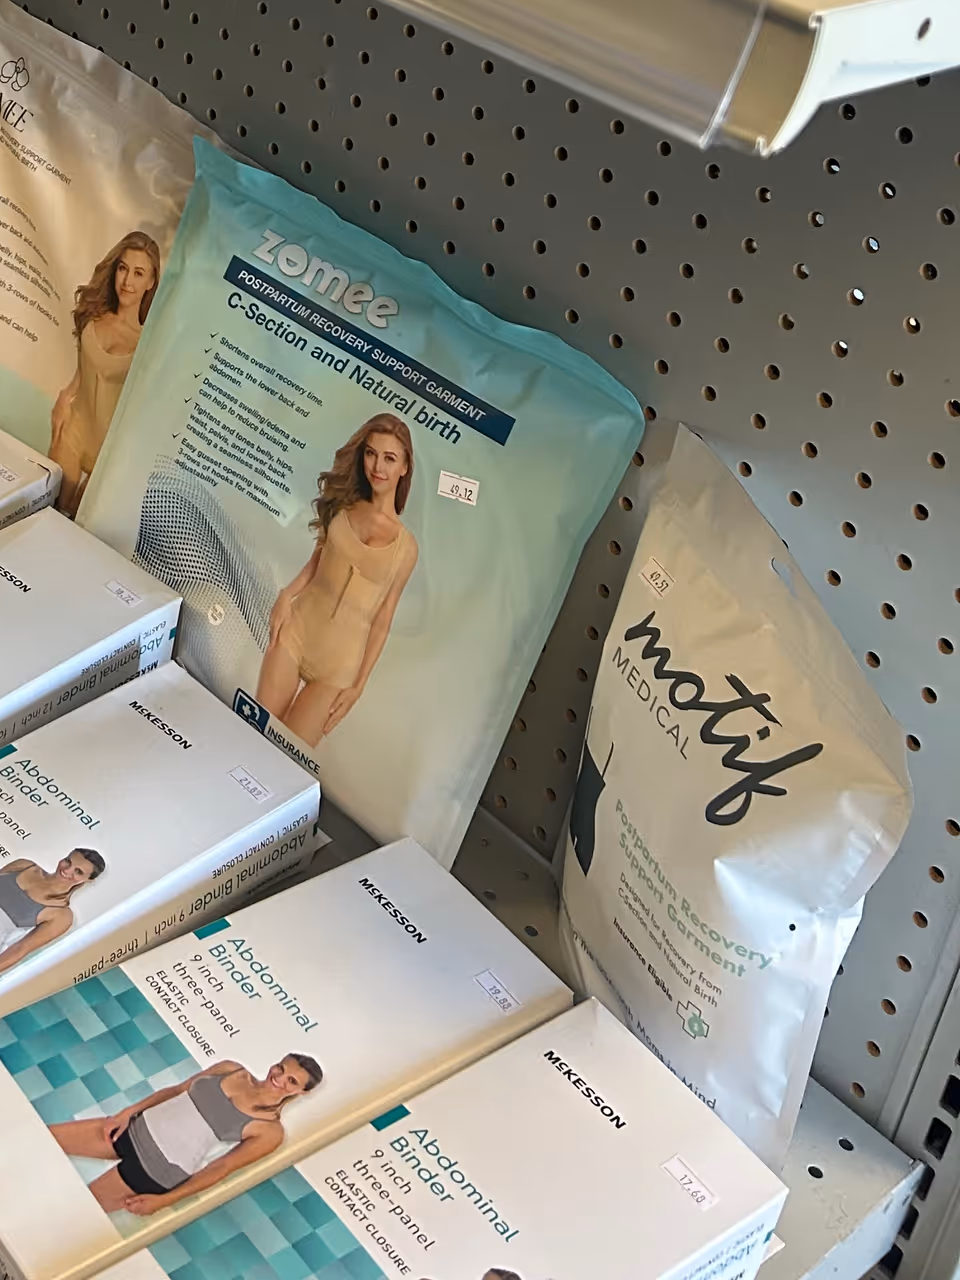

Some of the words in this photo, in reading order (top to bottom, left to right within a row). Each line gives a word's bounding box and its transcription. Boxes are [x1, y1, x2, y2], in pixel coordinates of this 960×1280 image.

[15, 144, 47, 166] SUPPORT
[45, 163, 71, 186] GARMENT
[251, 228, 400, 329] zomee
[208, 363, 241, 387] abdomen.
[219, 336, 249, 360] Shortens
[250, 357, 276, 375] overall
[275, 372, 307, 395] recovery
[306, 391, 322, 406] time.
[227, 292, 307, 350] C-Section
[310, 346, 350, 373] and
[348, 365, 416, 414] Natural
[413, 405, 460, 444] birth
[238, 270, 310, 317] POSTPARTUM
[309, 313, 371, 352] RECOVERY
[371, 348, 427, 385] SUPPORT
[425, 381, 485, 420] GARMENT
[202, 377, 238, 404] Decreases
[238, 402, 290, 439] swelling/edema
[290, 436, 306, 449] and
[213, 352, 244, 376] Supports
[244, 372, 257, 384] the
[257, 380, 278, 396] lower
[277, 392, 295, 408] back
[294, 405, 310, 417] and
[198, 388, 212, 400] can
[211, 396, 227, 410] help
[227, 406, 235, 415] to
[234, 412, 259, 432] reduce
[258, 427, 288, 452] bruising.
[180, 437, 197, 453] Easy
[196, 450, 222, 468] gusset
[222, 465, 252, 487] opening
[253, 483, 268, 497] with
[450, 484, 473, 501] 49.12
[612, 646, 690, 760] MEDICAL
[624, 610, 824, 827] motif
[266, 722, 322, 777] INSURANCE
[14, 759, 99, 829] Abdominal
[236, 830, 307, 888] Abdominal
[615, 799, 676, 900] Postpartum
[679, 891, 773, 969] Recovery
[188, 878, 233, 915] Binder
[618, 832, 663, 904] Support
[667, 897, 746, 979] Garment
[155, 969, 189, 1005] ELASTIC
[189, 954, 202, 962] 9
[197, 964, 223, 992] inch
[208, 944, 261, 998] Binder
[227, 939, 317, 1032] Abdominal
[613, 917, 646, 965] Insurance
[647, 963, 672, 1001] Eligible
[145, 975, 181, 1013] CONTACT
[177, 1014, 215, 1057] CLOSURE
[172, 962, 239, 1037] three-panel
[335, 1169, 375, 1211] ELASTIC
[370, 1148, 384, 1158] 9
[380, 1160, 411, 1194] inch
[389, 1136, 453, 1201] Binder
[408, 1129, 518, 1241] Abdominal
[324, 1176, 368, 1221] CONTACT
[365, 1223, 411, 1275] CLOSURE
[352, 1159, 434, 1250] three-panel
